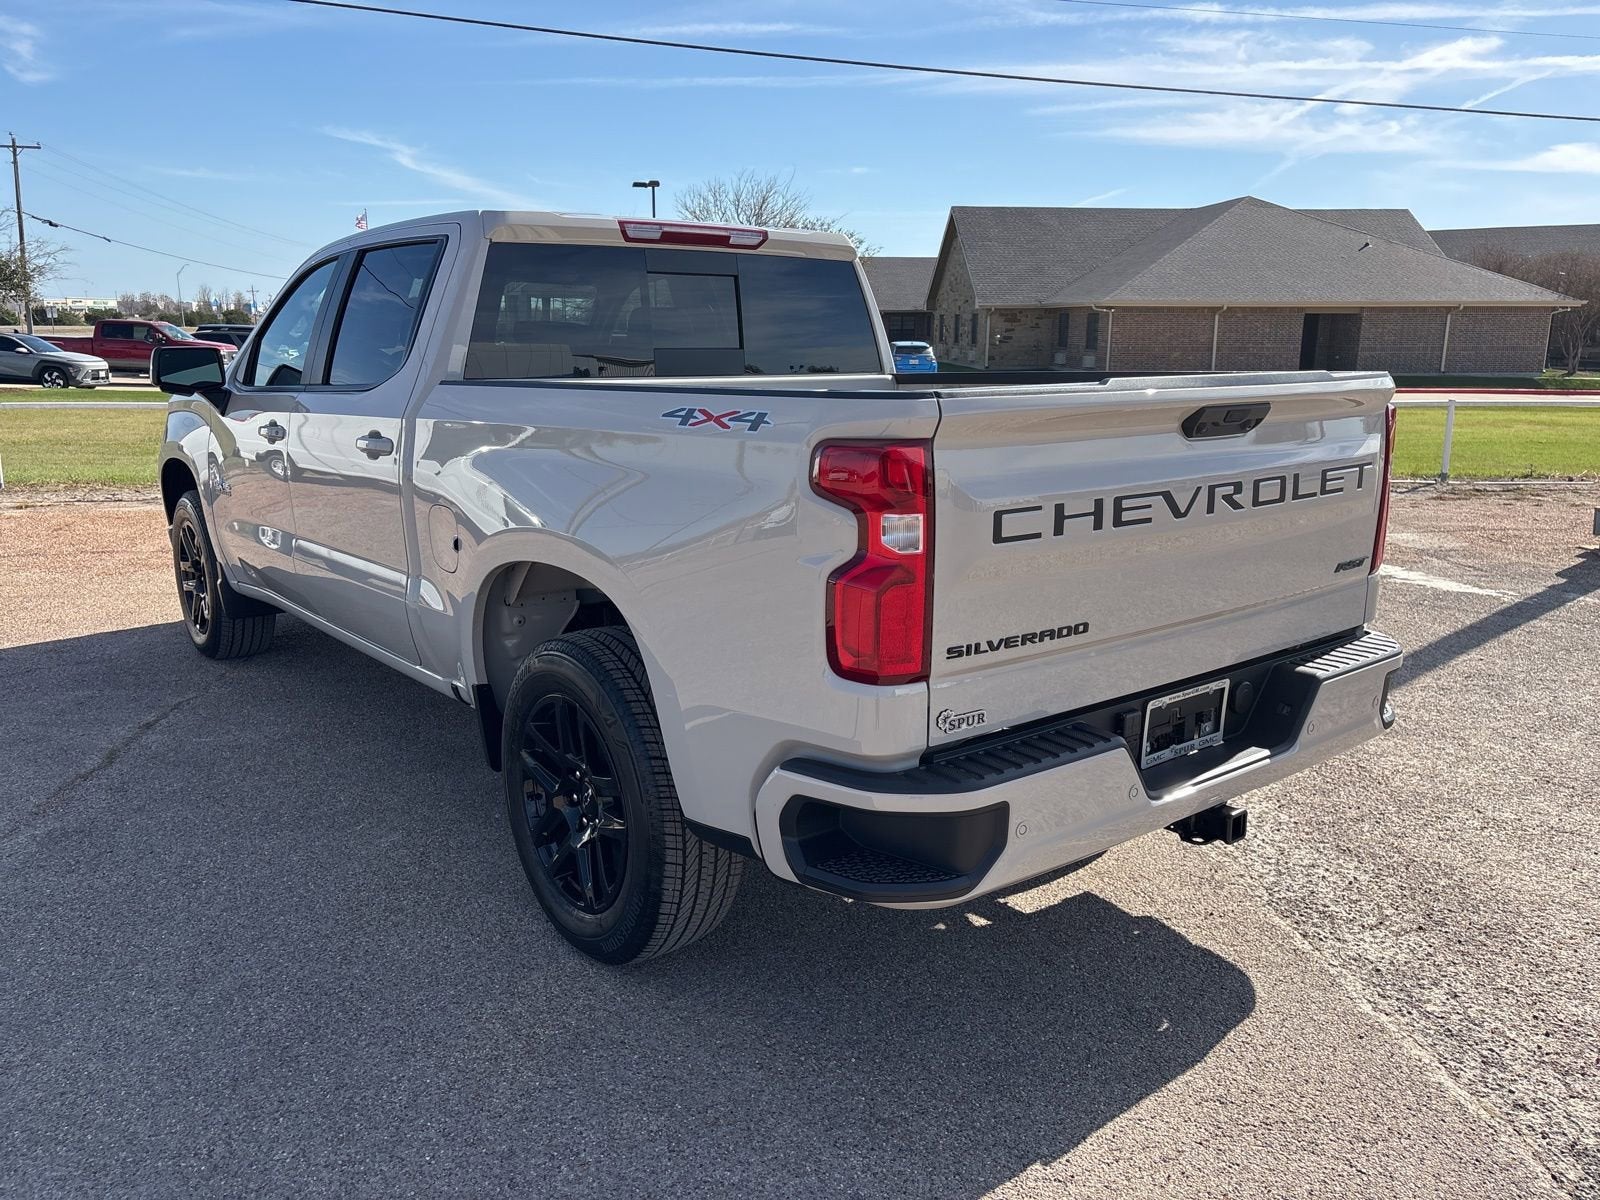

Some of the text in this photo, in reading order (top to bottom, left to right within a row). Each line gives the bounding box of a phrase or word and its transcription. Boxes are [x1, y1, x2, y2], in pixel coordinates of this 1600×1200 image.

[993, 462, 1373, 544] CHEVROLET
[946, 621, 1090, 660] SILVERADO
[948, 713, 985, 731] SPUR
[1146, 735, 1218, 766] GMC SPUR GMC
